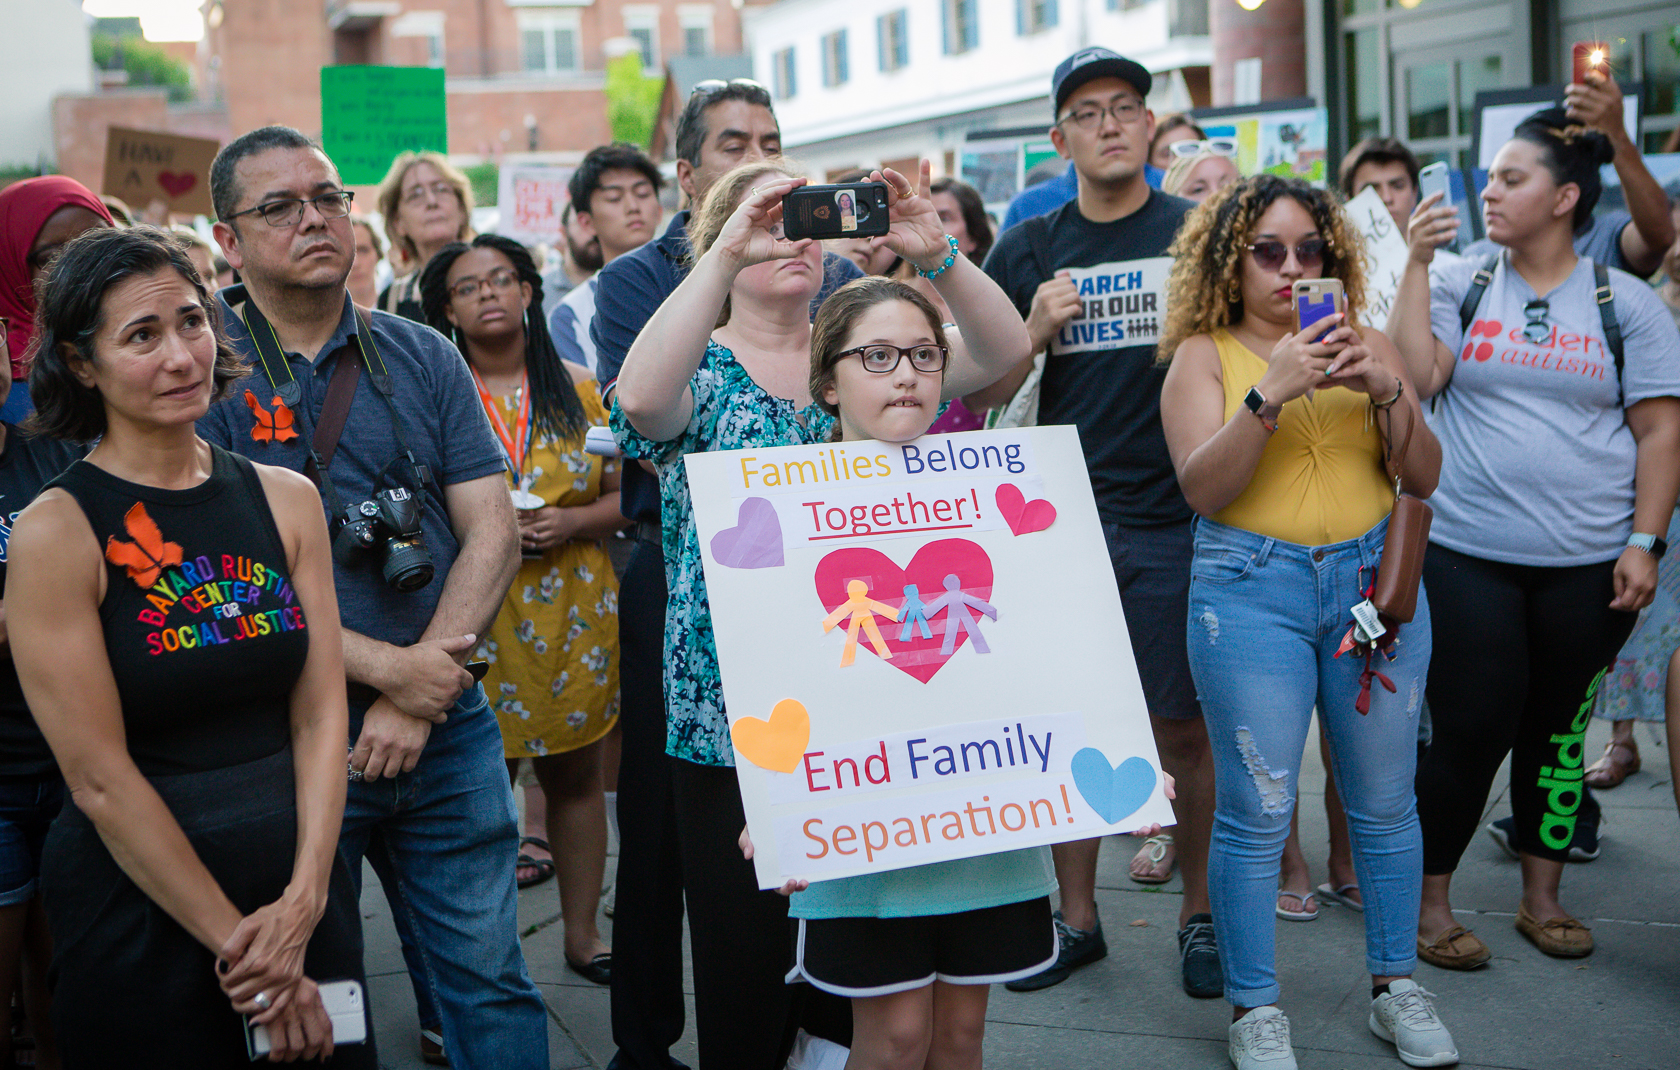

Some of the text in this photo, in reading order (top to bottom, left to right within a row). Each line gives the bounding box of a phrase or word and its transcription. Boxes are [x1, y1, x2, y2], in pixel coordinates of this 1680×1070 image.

[1070, 270, 1143, 297] ARCH
[1108, 292, 1158, 317] OUR
[1060, 320, 1125, 347] LIVES
[1501, 348, 1606, 382] autism
[740, 439, 1026, 489] Families Belong
[802, 488, 982, 535] Together!
[136, 554, 295, 628] BAYARD RUSTIN
[181, 581, 262, 614] CENTER
[212, 601, 243, 620] FOR
[145, 606, 306, 656] SOCIAL JUSTICE
[803, 722, 1053, 793] End Family
[1536, 665, 1610, 851] adidas
[802, 783, 1075, 863] Separation!
